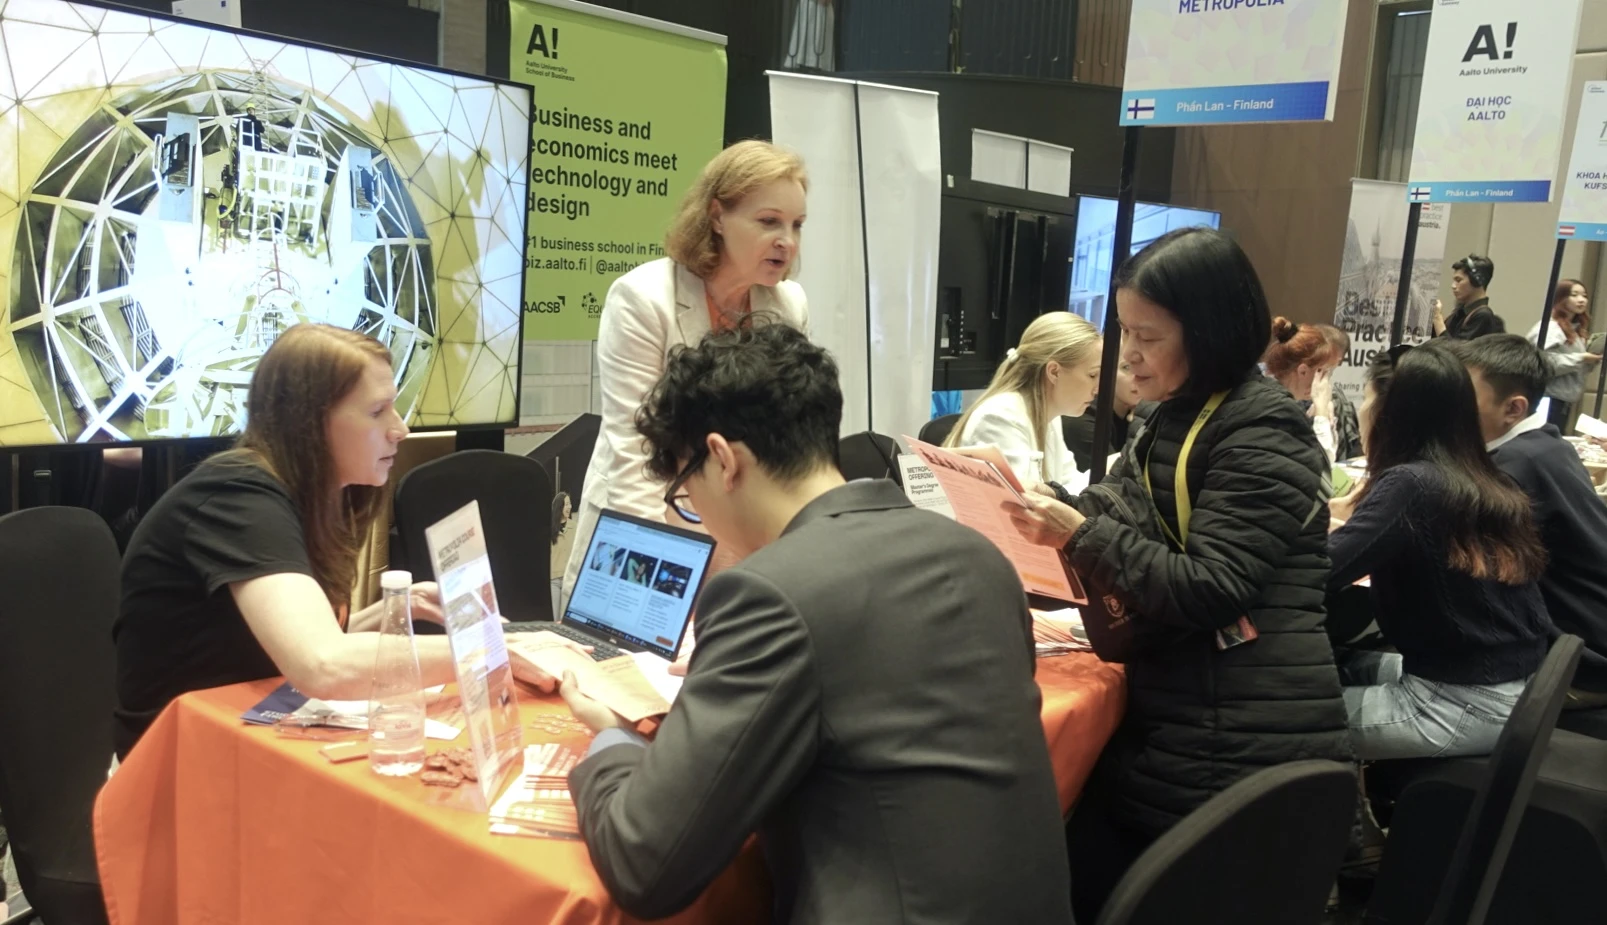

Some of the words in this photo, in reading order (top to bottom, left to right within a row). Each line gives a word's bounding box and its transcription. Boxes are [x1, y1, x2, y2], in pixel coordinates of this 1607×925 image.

[526, 24, 558, 59] A!
[1461, 21, 1518, 62] A!
[526, 60, 540, 70] Aalto
[540, 63, 568, 74] University
[526, 67, 544, 77] School
[551, 71, 576, 81] Business
[1459, 68, 1481, 77] Aalto
[1483, 65, 1528, 75] University
[1204, 101, 1224, 112] Lan
[1233, 98, 1274, 111] Finland
[1466, 97, 1486, 109] ĐẠI
[1488, 95, 1512, 108] HỌC
[1467, 110, 1506, 121] AALTO
[618, 121, 651, 140] and
[634, 151, 678, 171] meet
[532, 165, 632, 198] echnology
[636, 178, 668, 197] and
[1576, 171, 1601, 180] KHOA
[1465, 189, 1479, 197] Lan
[1485, 188, 1514, 197] Finland
[541, 237, 595, 252] business
[597, 240, 634, 254] school
[637, 243, 646, 255] in
[649, 243, 667, 256] Fin
